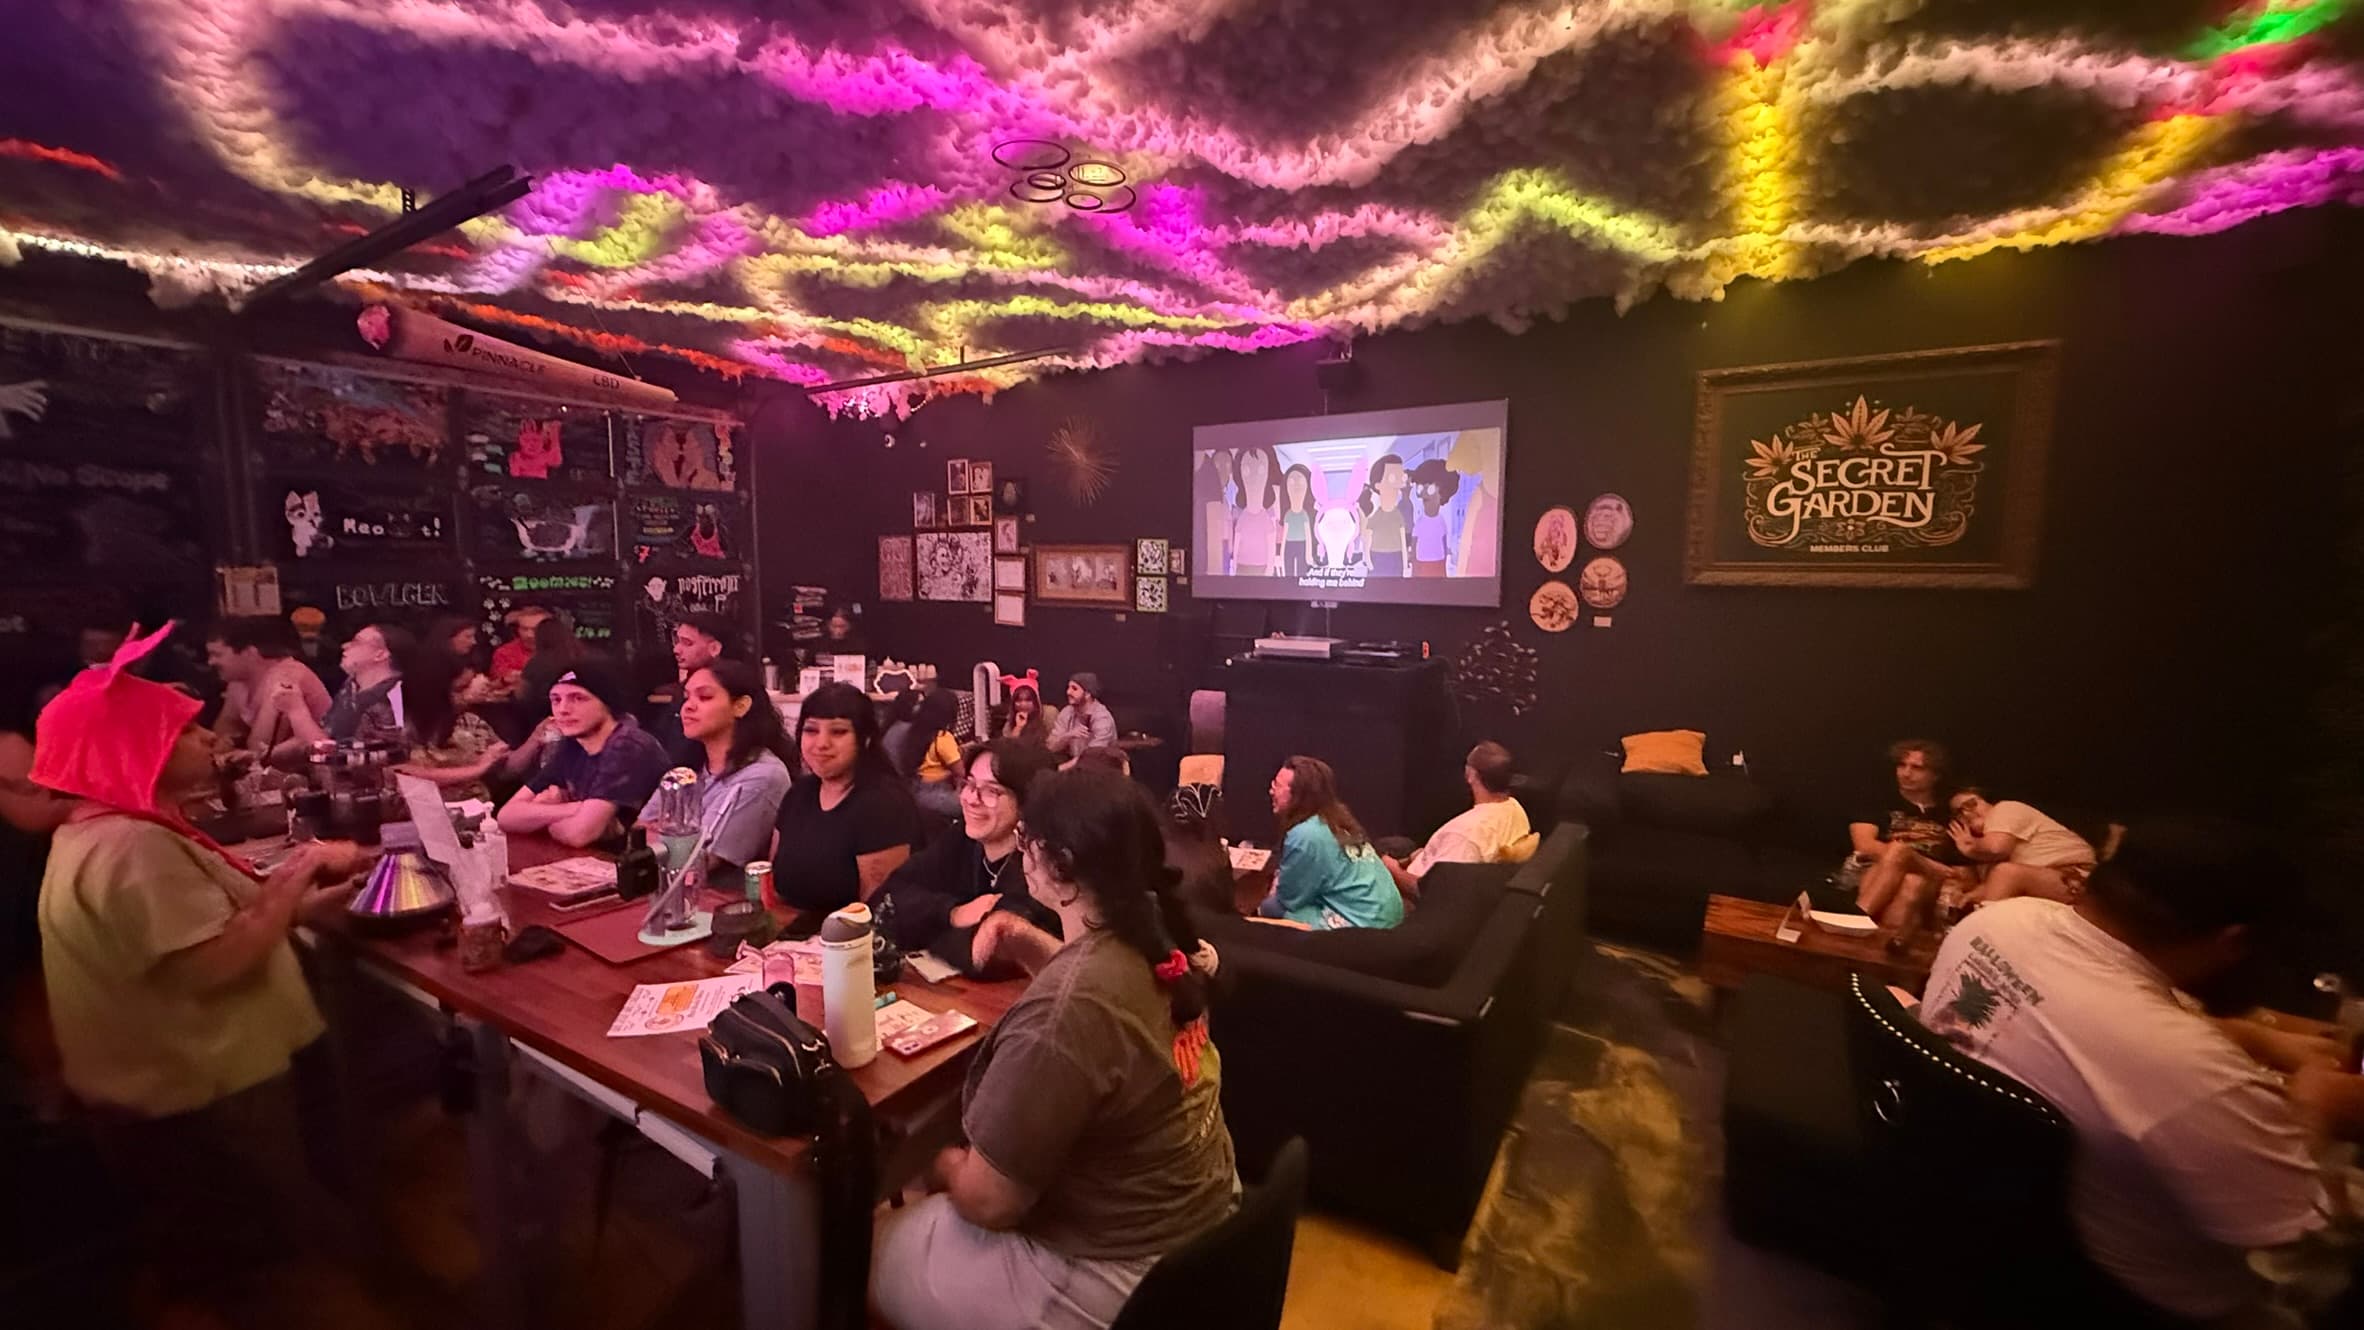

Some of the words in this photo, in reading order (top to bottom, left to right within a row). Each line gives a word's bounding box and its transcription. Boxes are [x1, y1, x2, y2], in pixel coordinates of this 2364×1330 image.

[472, 345, 548, 373] PINNACLE
[591, 374, 621, 389] CBD
[1790, 447, 1822, 460] THE
[1788, 443, 1947, 496] SECRET
[1766, 481, 1936, 544] GARDEN
[1810, 544, 1860, 553] MEMBERS
[1861, 544, 1889, 553] CLUB
[1306, 567, 1323, 577] And
[1299, 577, 1325, 588] holding
[1326, 579, 1338, 587] me
[1339, 578, 1365, 587] behind
[1969, 935, 2045, 1006] HALLOWEEN
